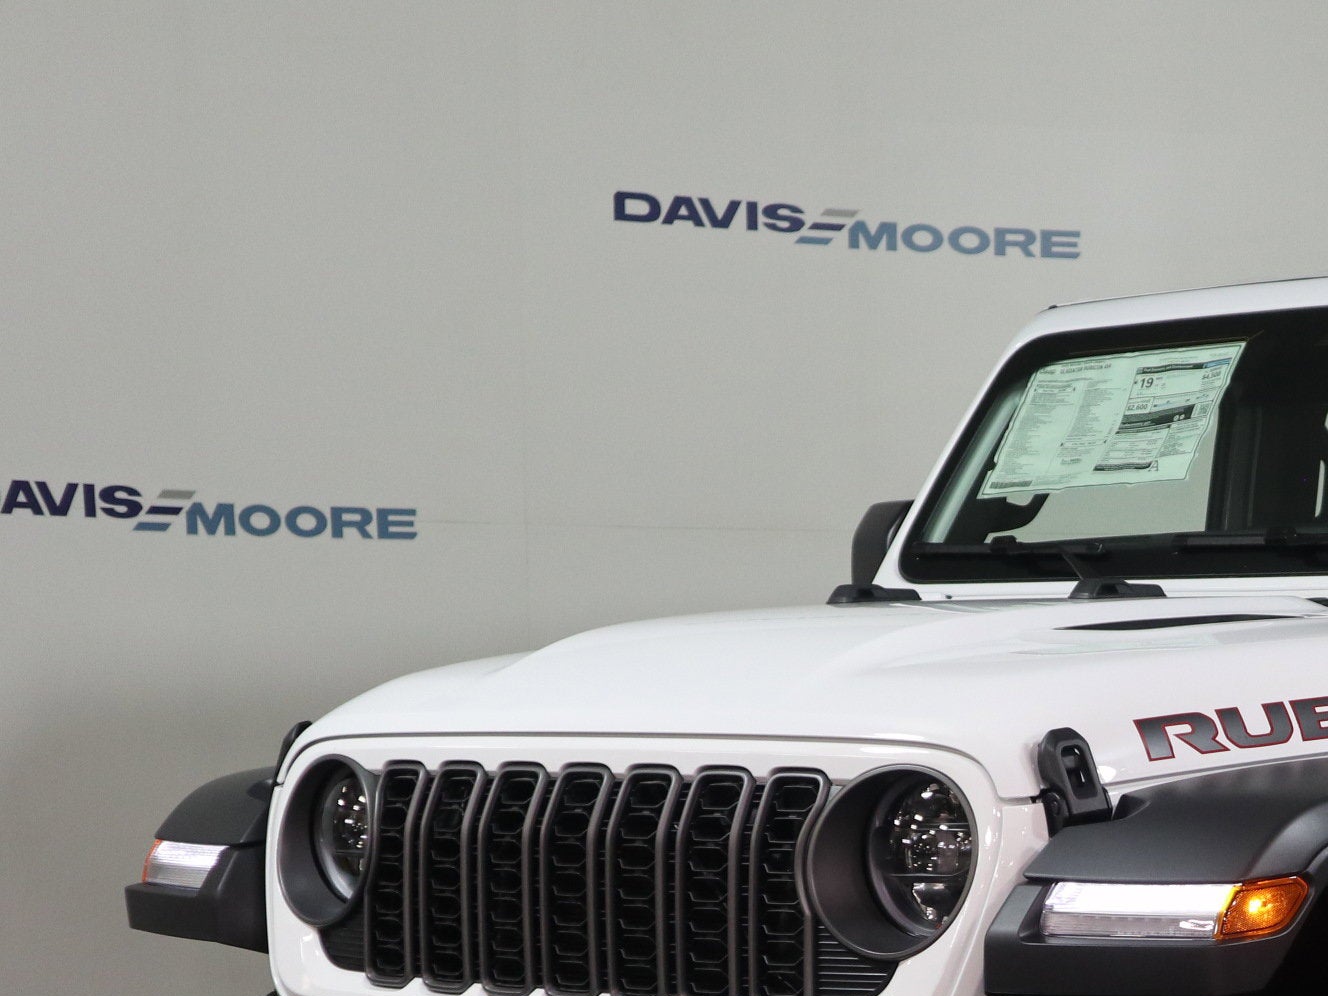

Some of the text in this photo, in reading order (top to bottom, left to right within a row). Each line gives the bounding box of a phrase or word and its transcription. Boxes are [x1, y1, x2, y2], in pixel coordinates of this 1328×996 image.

[613, 191, 1081, 259] DAVIS MOORE
[1140, 377, 1154, 388] 19
[0, 480, 418, 541] AVIS MOORE
